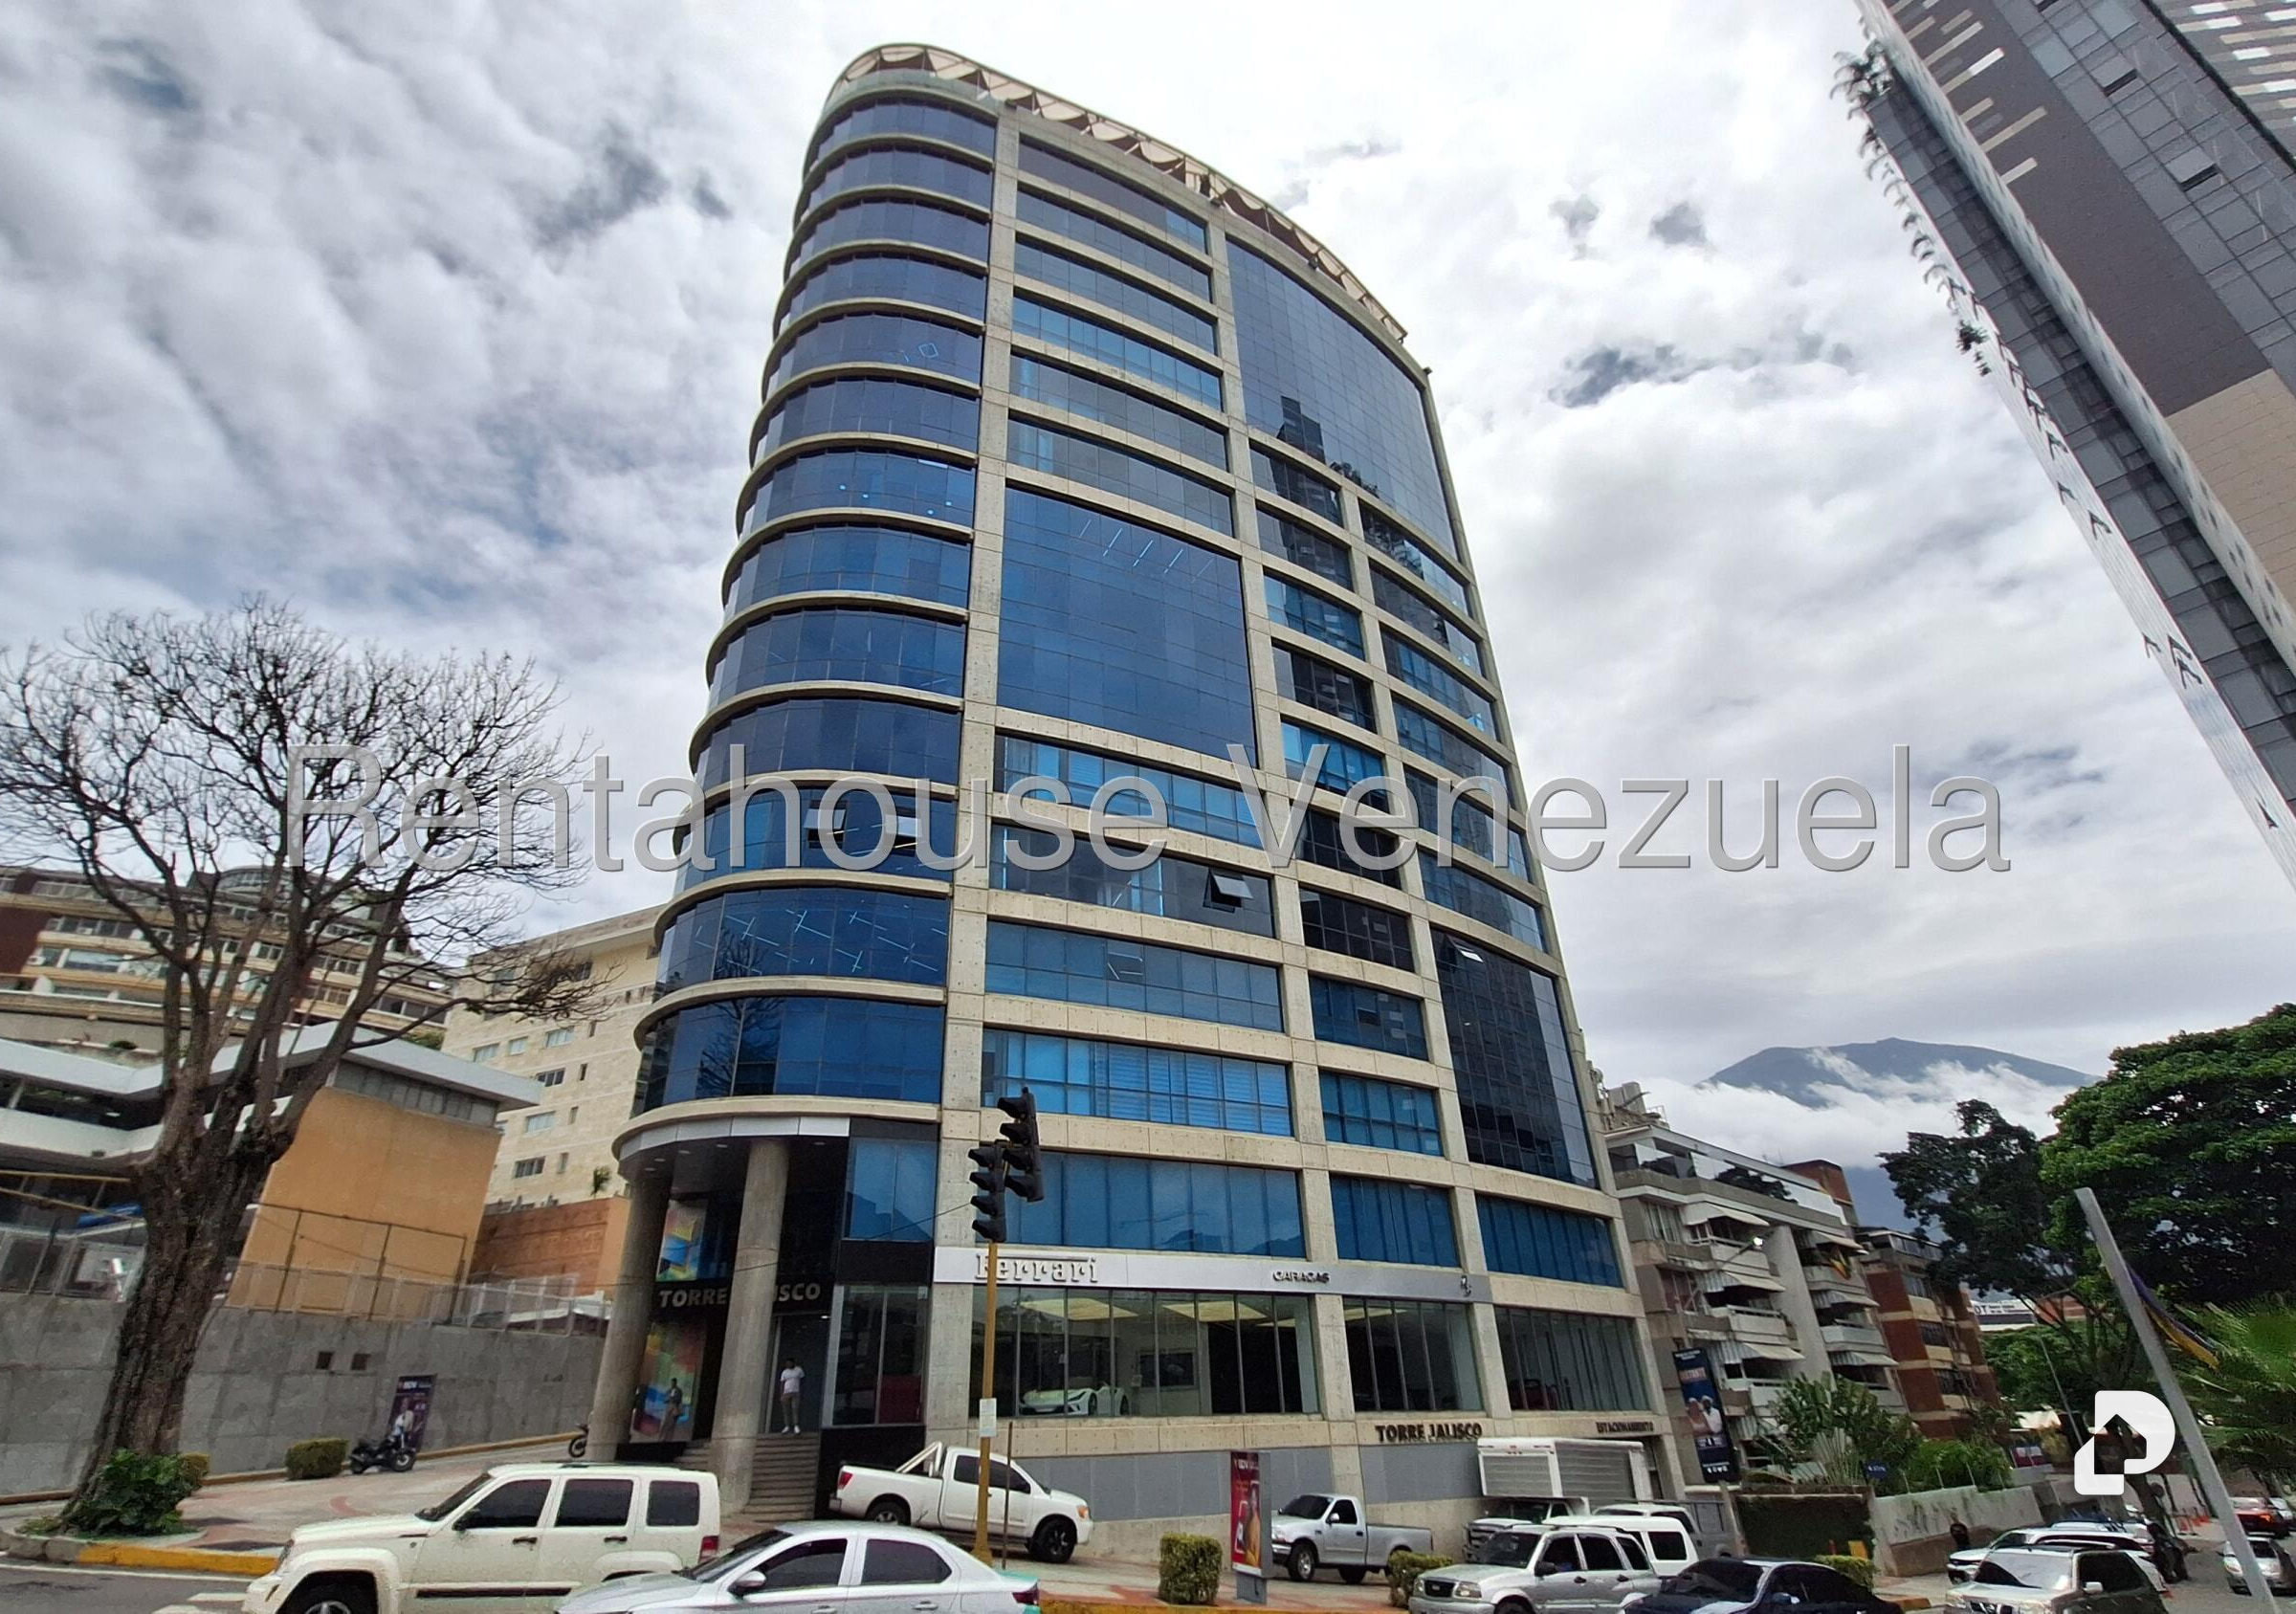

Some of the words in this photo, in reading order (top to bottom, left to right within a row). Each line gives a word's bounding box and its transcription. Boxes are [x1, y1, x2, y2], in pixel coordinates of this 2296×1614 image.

[1272, 1270, 1330, 1284] CARACAS
[659, 1288, 728, 1308] TORRE
[1376, 1424, 1424, 1442] TORRE
[1429, 1422, 1482, 1440] JALISCO
